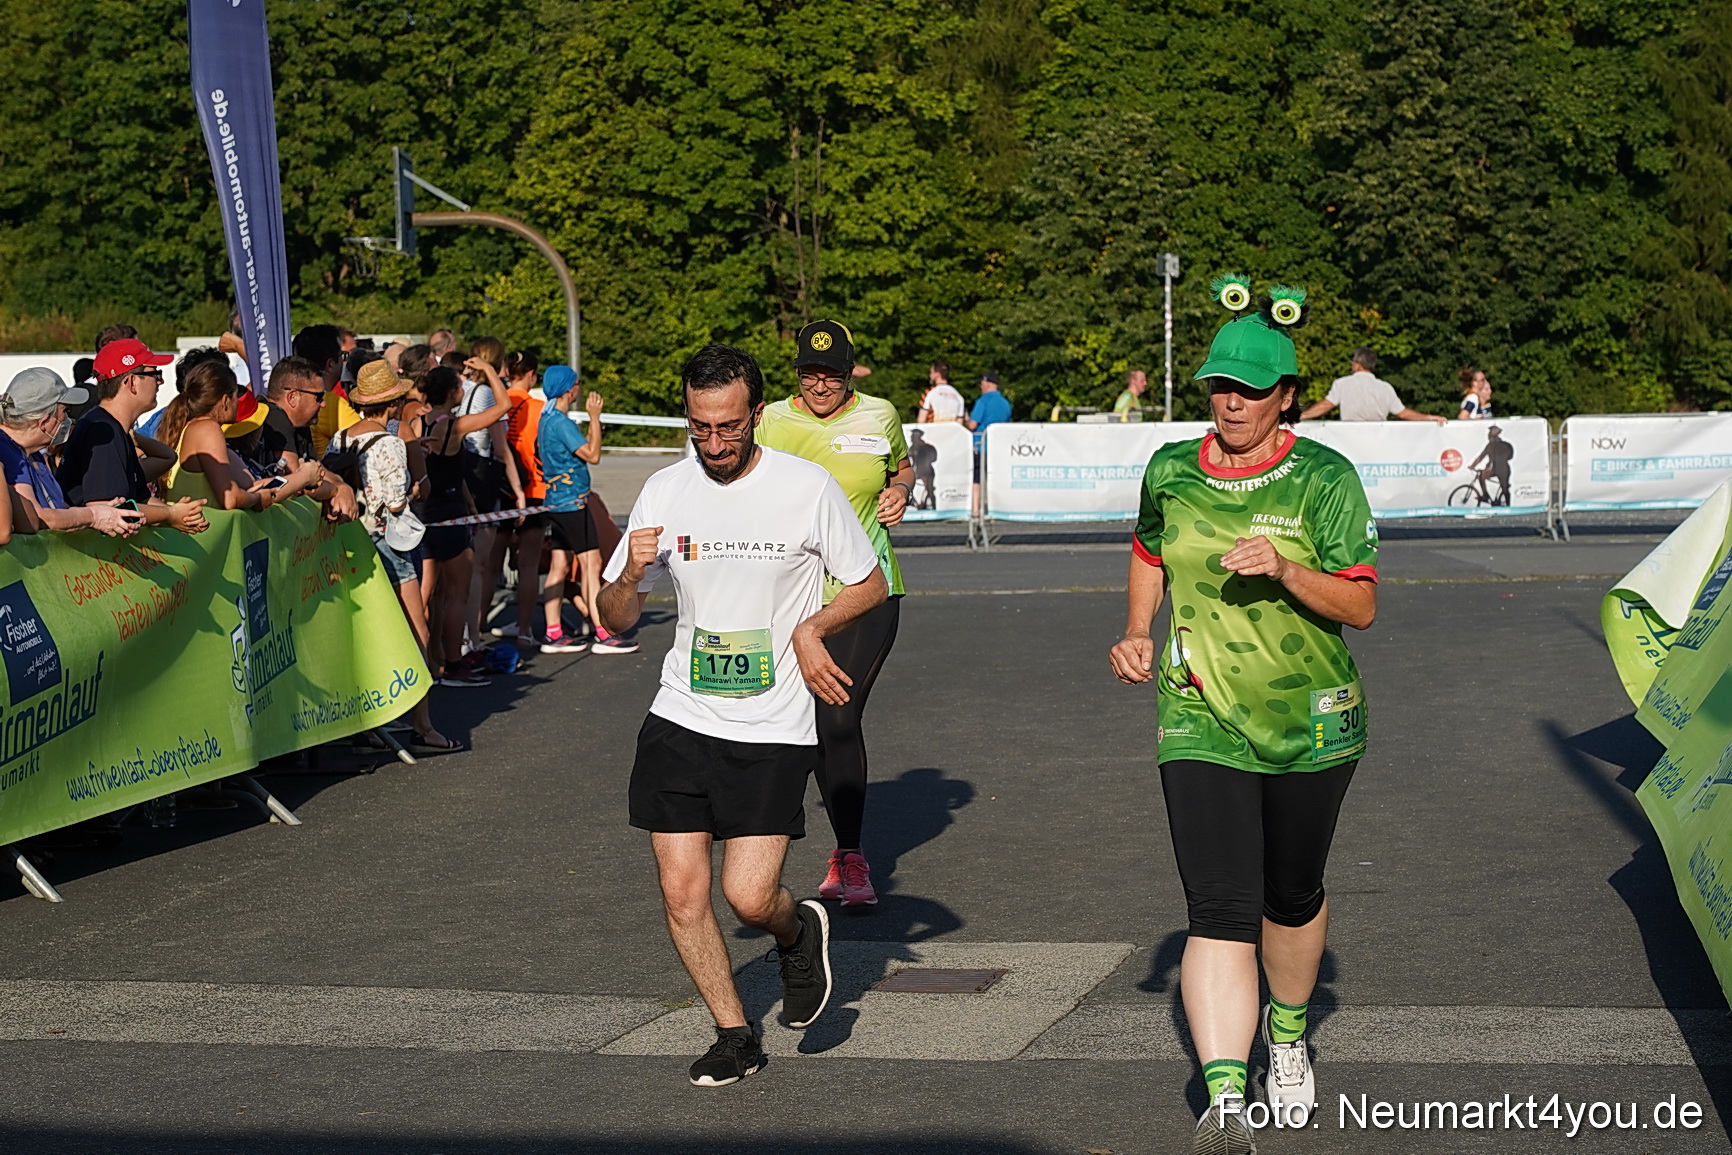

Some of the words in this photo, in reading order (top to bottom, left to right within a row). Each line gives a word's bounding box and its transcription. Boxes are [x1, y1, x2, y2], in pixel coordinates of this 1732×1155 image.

[814, 333, 830, 346] BVB
[1591, 437, 1627, 450] NOW
[1011, 444, 1046, 457] NOW
[1362, 462, 1442, 477] FAHRRÄDER
[1593, 460, 1643, 472] E-BIKES
[1645, 459, 1655, 470] &
[1013, 467, 1066, 479] E-BIKES
[1067, 468, 1077, 479] &
[701, 541, 786, 553] SCHWARZ
[5, 617, 39, 645] Fischer
[16, 634, 44, 655] AUTOMOBILE
[706, 653, 750, 676] 179
[760, 655, 770, 686] 2022
[699, 674, 732, 685] Almarawi
[733, 676, 761, 685] Yaman
[1339, 705, 1359, 734] 30
[1315, 722, 1324, 749] RUN
[1323, 736, 1352, 748] Benkler
